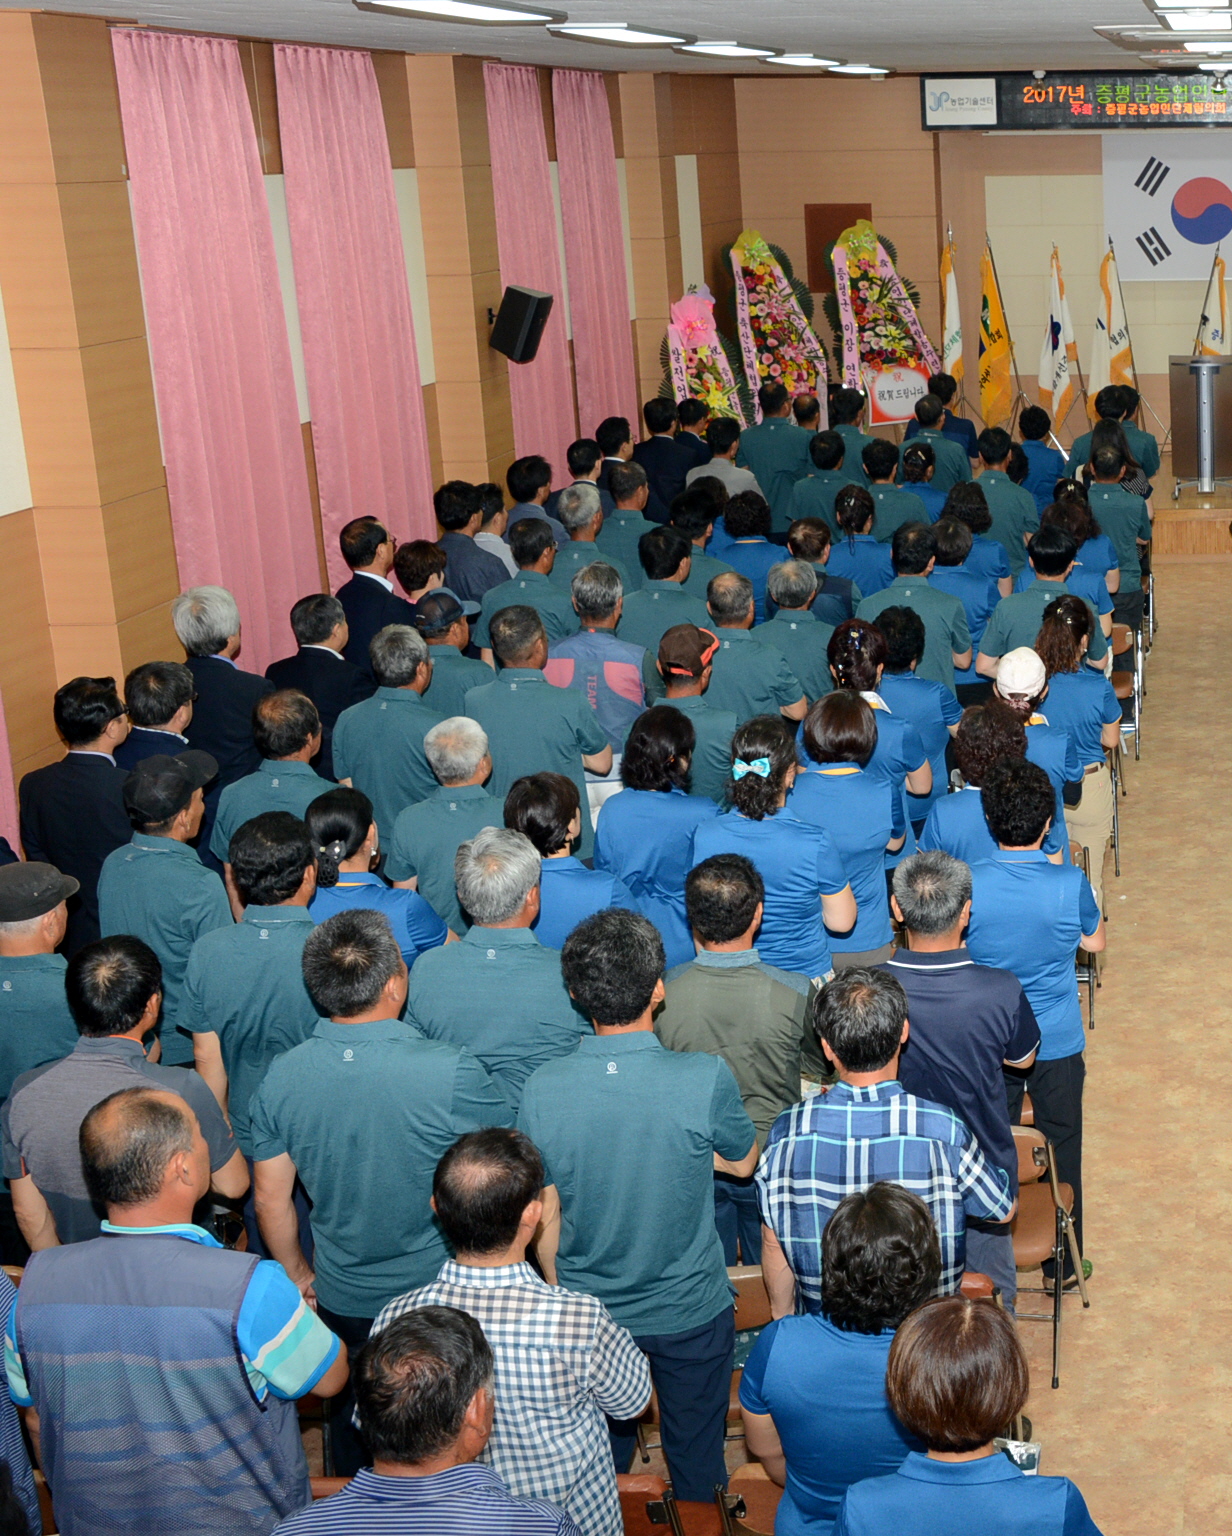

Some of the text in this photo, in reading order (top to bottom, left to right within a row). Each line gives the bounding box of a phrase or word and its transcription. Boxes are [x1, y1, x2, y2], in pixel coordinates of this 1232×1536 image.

[951, 96, 994, 106] 농업기술센터
[1023, 85, 1085, 104] 2017년
[837, 267, 850, 312] 증평군
[844, 321, 855, 352] 이장
